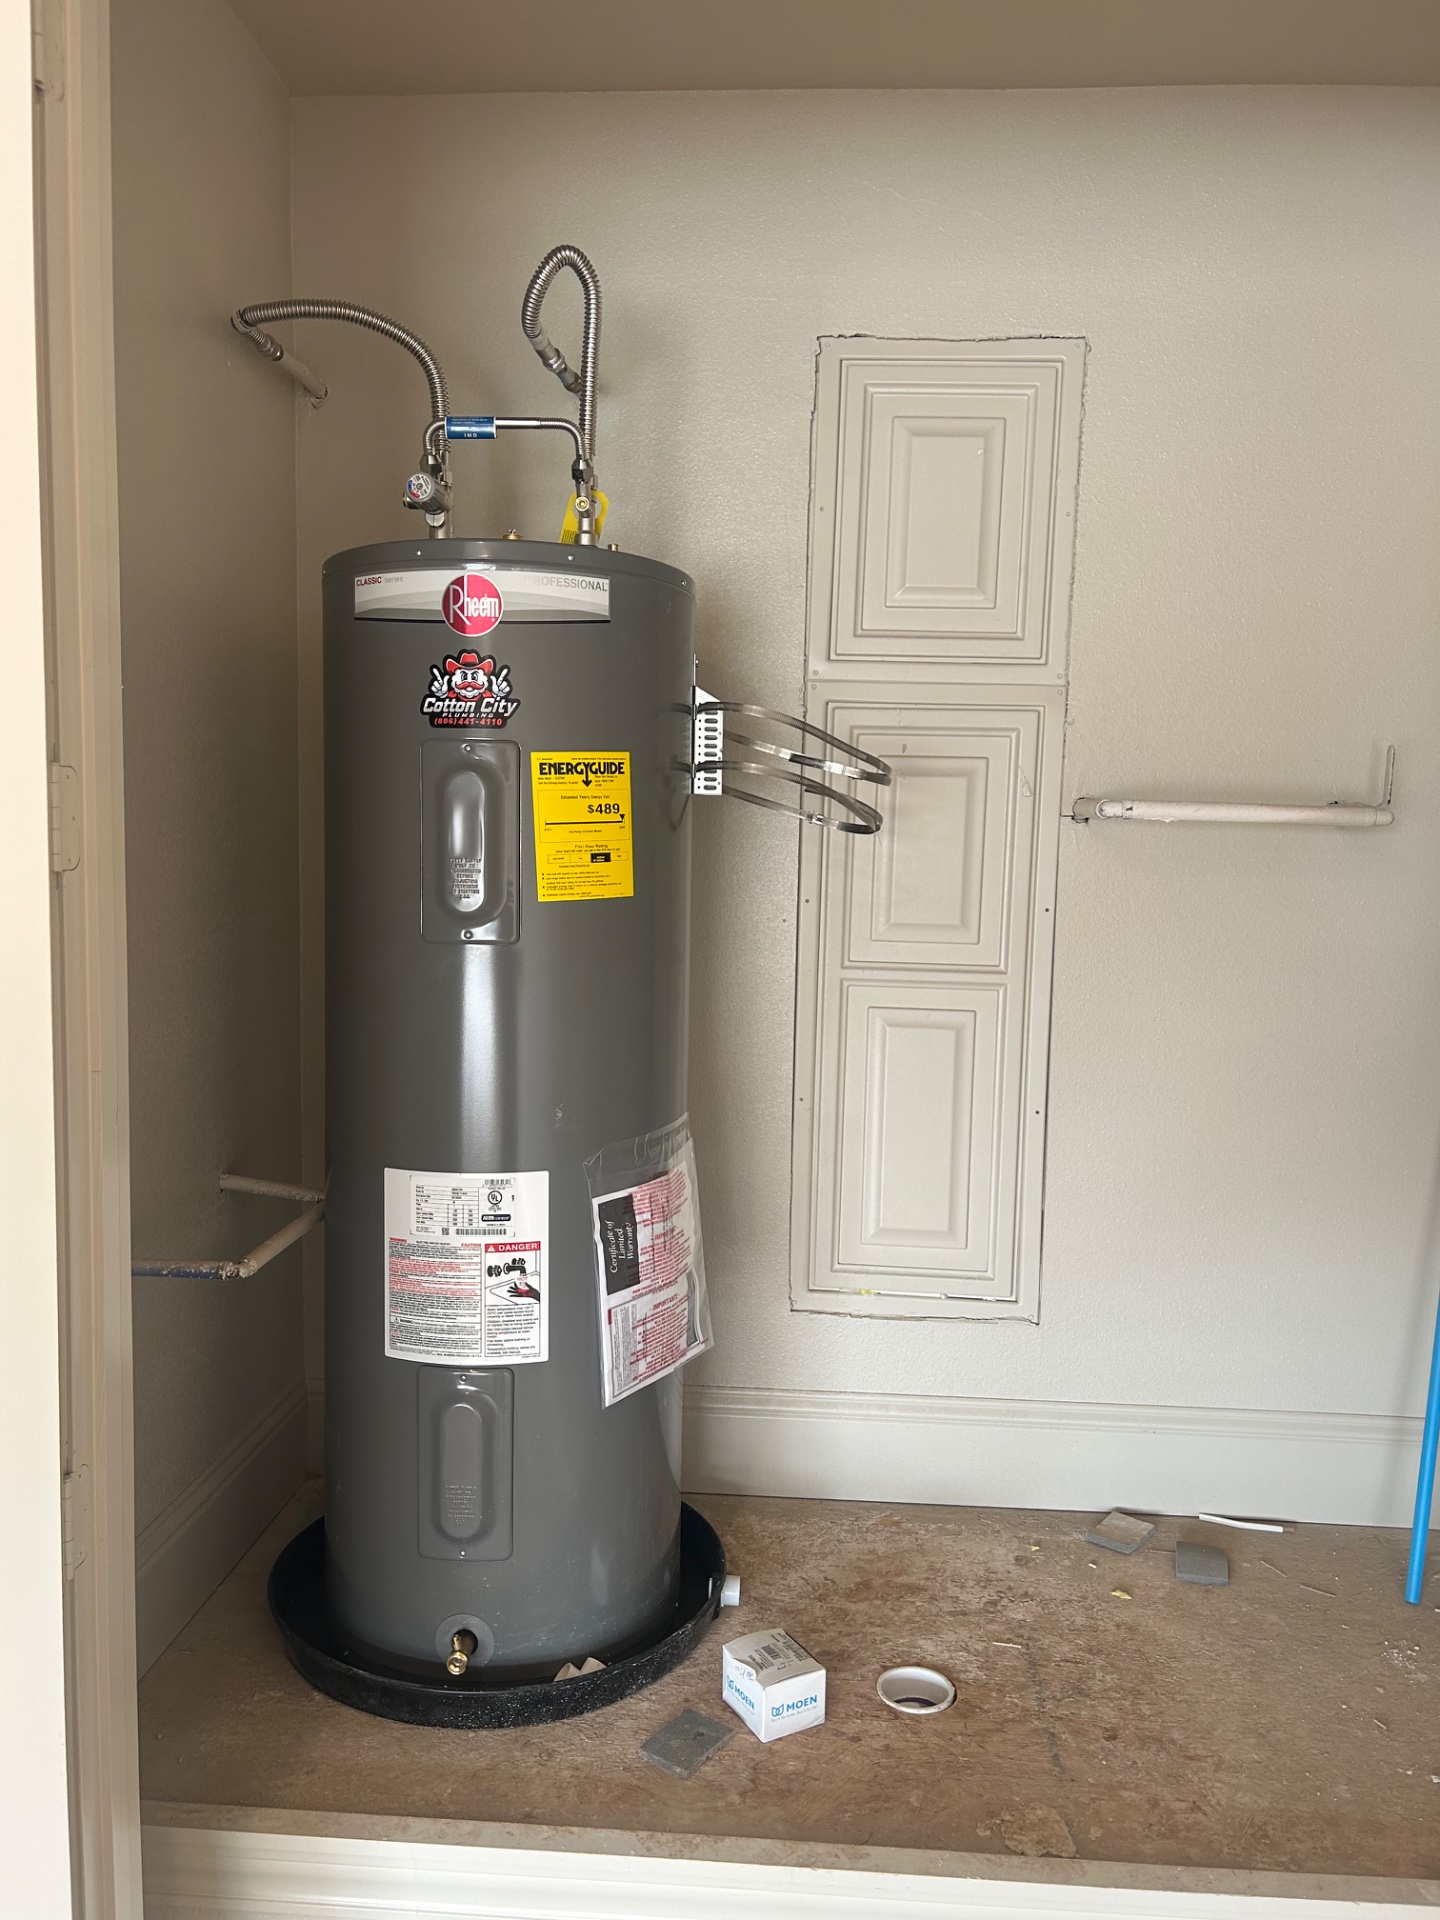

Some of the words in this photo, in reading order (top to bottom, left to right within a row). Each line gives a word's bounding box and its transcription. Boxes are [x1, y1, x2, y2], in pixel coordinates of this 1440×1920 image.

[356, 576, 382, 586] CLASSIC
[384, 576, 404, 584] series
[449, 572, 499, 626] Rheem
[423, 697, 476, 712] Cotton
[480, 696, 518, 716] City
[539, 762, 625, 776] ENERGYGUIDE
[587, 803, 620, 815] $489
[604, 1220, 614, 1229] of
[498, 1243, 538, 1252] DANGER
[614, 1228, 626, 1259] Limited
[626, 1222, 635, 1260] Warranty
[606, 1230, 618, 1273] Certificate
[734, 1685, 755, 1710] MOEN
[786, 1695, 818, 1712] MOEN
